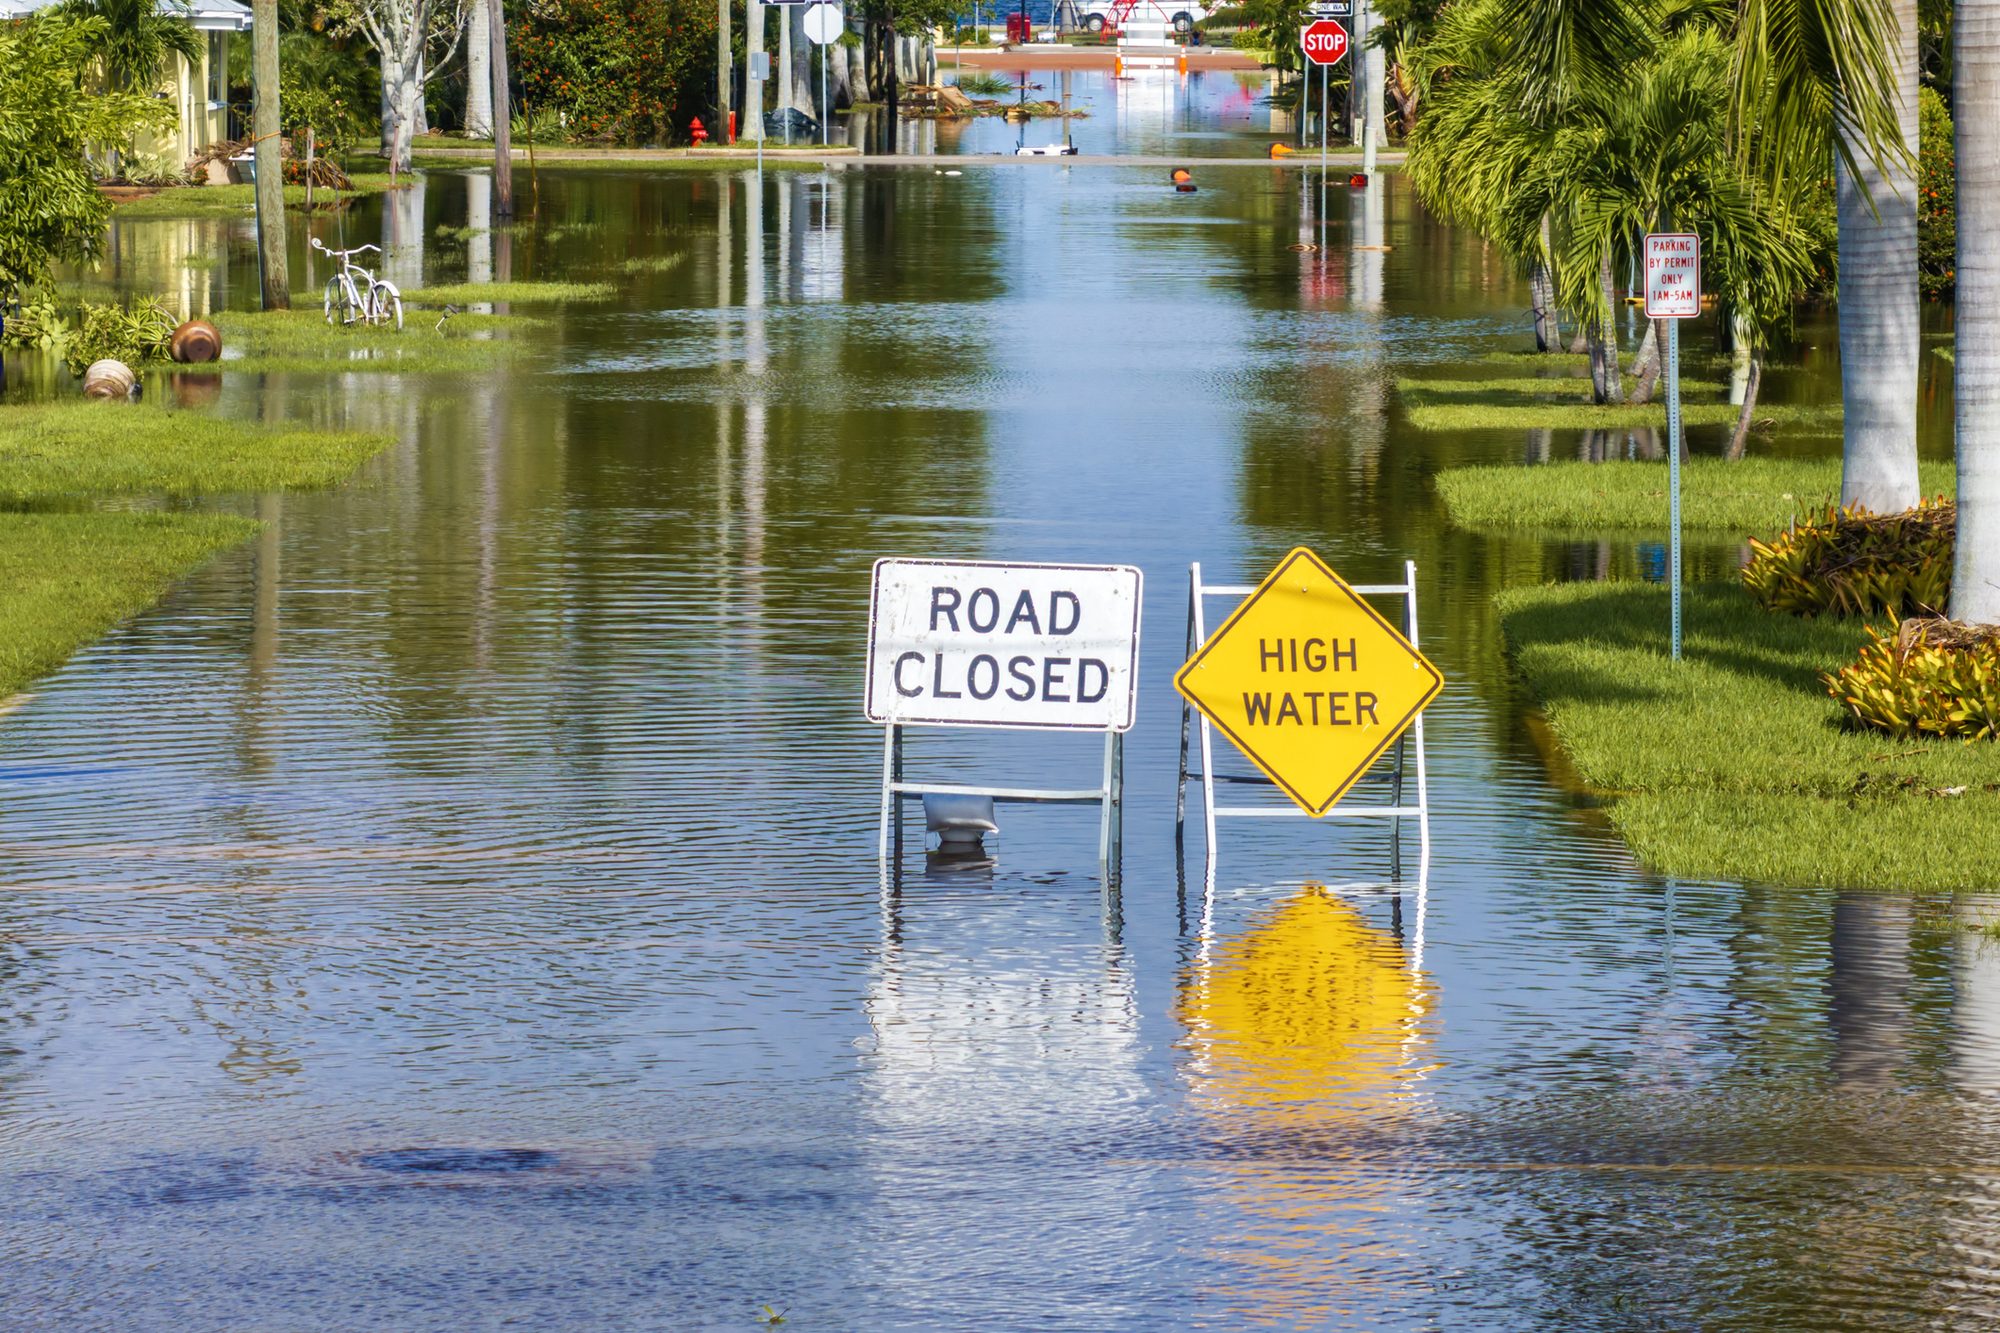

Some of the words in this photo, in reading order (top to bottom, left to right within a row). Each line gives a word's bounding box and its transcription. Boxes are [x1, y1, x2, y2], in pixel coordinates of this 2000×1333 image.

[1306, 34, 1344, 51] STOP
[1653, 241, 1690, 251] PARKING
[1650, 258, 1661, 268] BY
[1664, 257, 1694, 267] PERMIT
[1661, 274, 1683, 284] ONLY
[1653, 290, 1692, 300] 1AM-5AM
[929, 586, 1081, 636] ROAD
[1259, 638, 1358, 673] HIGH
[894, 651, 1109, 703] CLOSED
[1242, 691, 1380, 726] WATER
